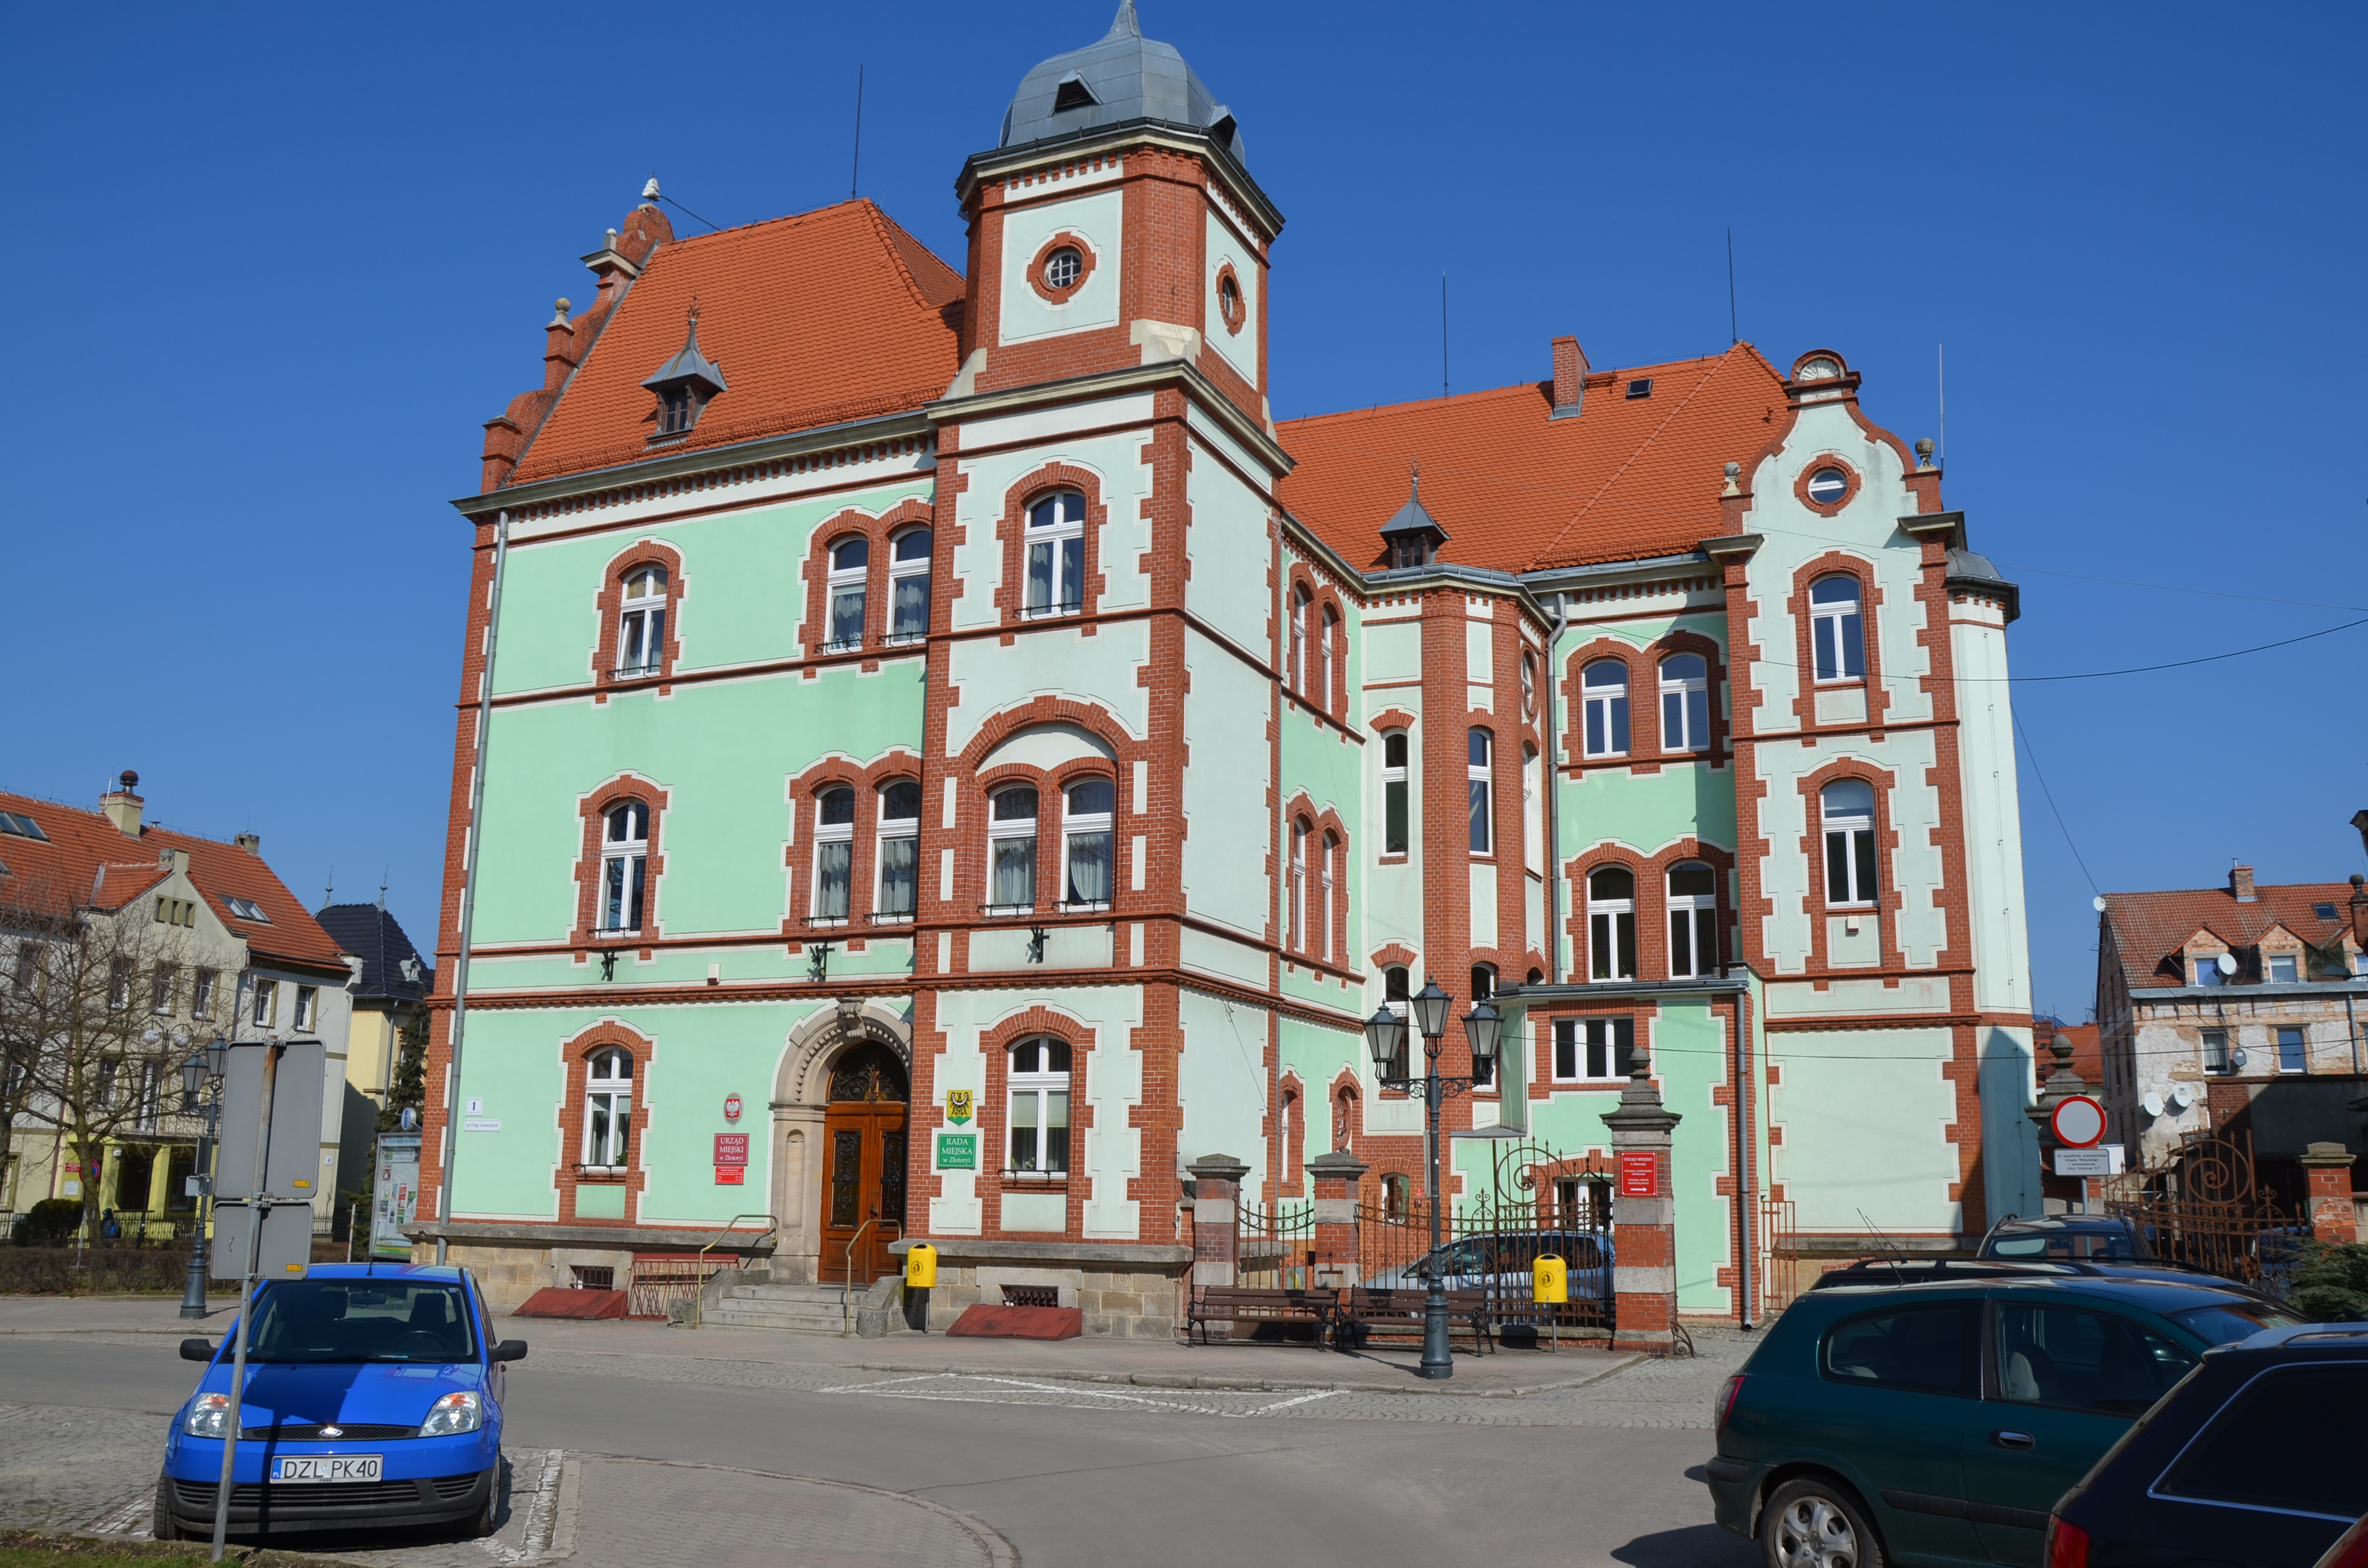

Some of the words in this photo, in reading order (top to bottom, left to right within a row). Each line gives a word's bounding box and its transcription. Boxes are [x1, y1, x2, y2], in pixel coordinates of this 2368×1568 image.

[472, 1101, 476, 1111] 1
[720, 1137, 744, 1145] URZĄD
[719, 1146, 744, 1154] MIEJSKI
[941, 1147, 973, 1156] MIEJSKA
[284, 1460, 324, 1478] DZL
[331, 1460, 378, 1478] PK40
